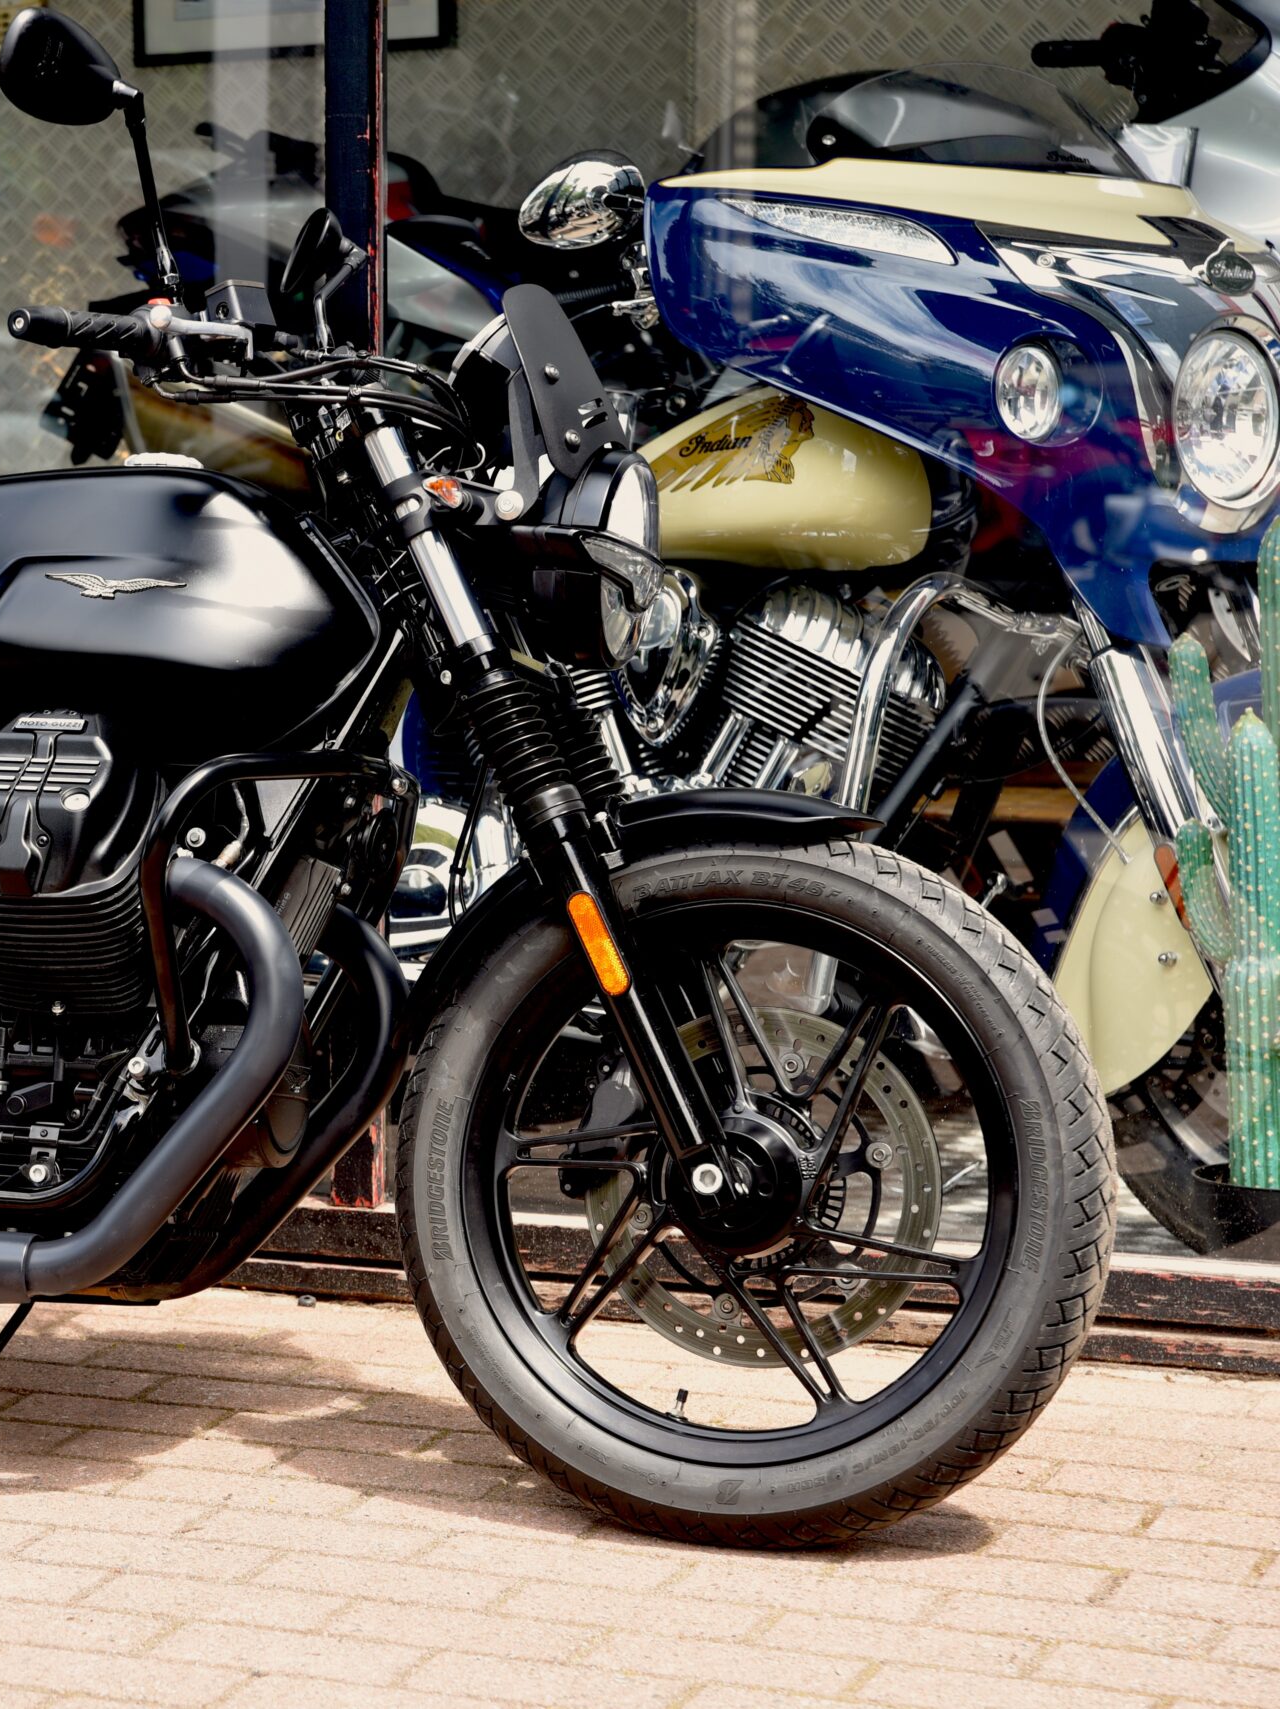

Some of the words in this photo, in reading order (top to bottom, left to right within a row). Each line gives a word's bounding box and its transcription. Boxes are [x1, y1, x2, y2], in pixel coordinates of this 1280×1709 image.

[1210, 260, 1254, 279] Indian
[679, 432, 753, 458] Indian
[632, 870, 744, 899] BATTLAX
[426, 1098, 455, 1261] BRIDGESTONE
[1020, 1098, 1049, 1274] BRIDGESTONE
